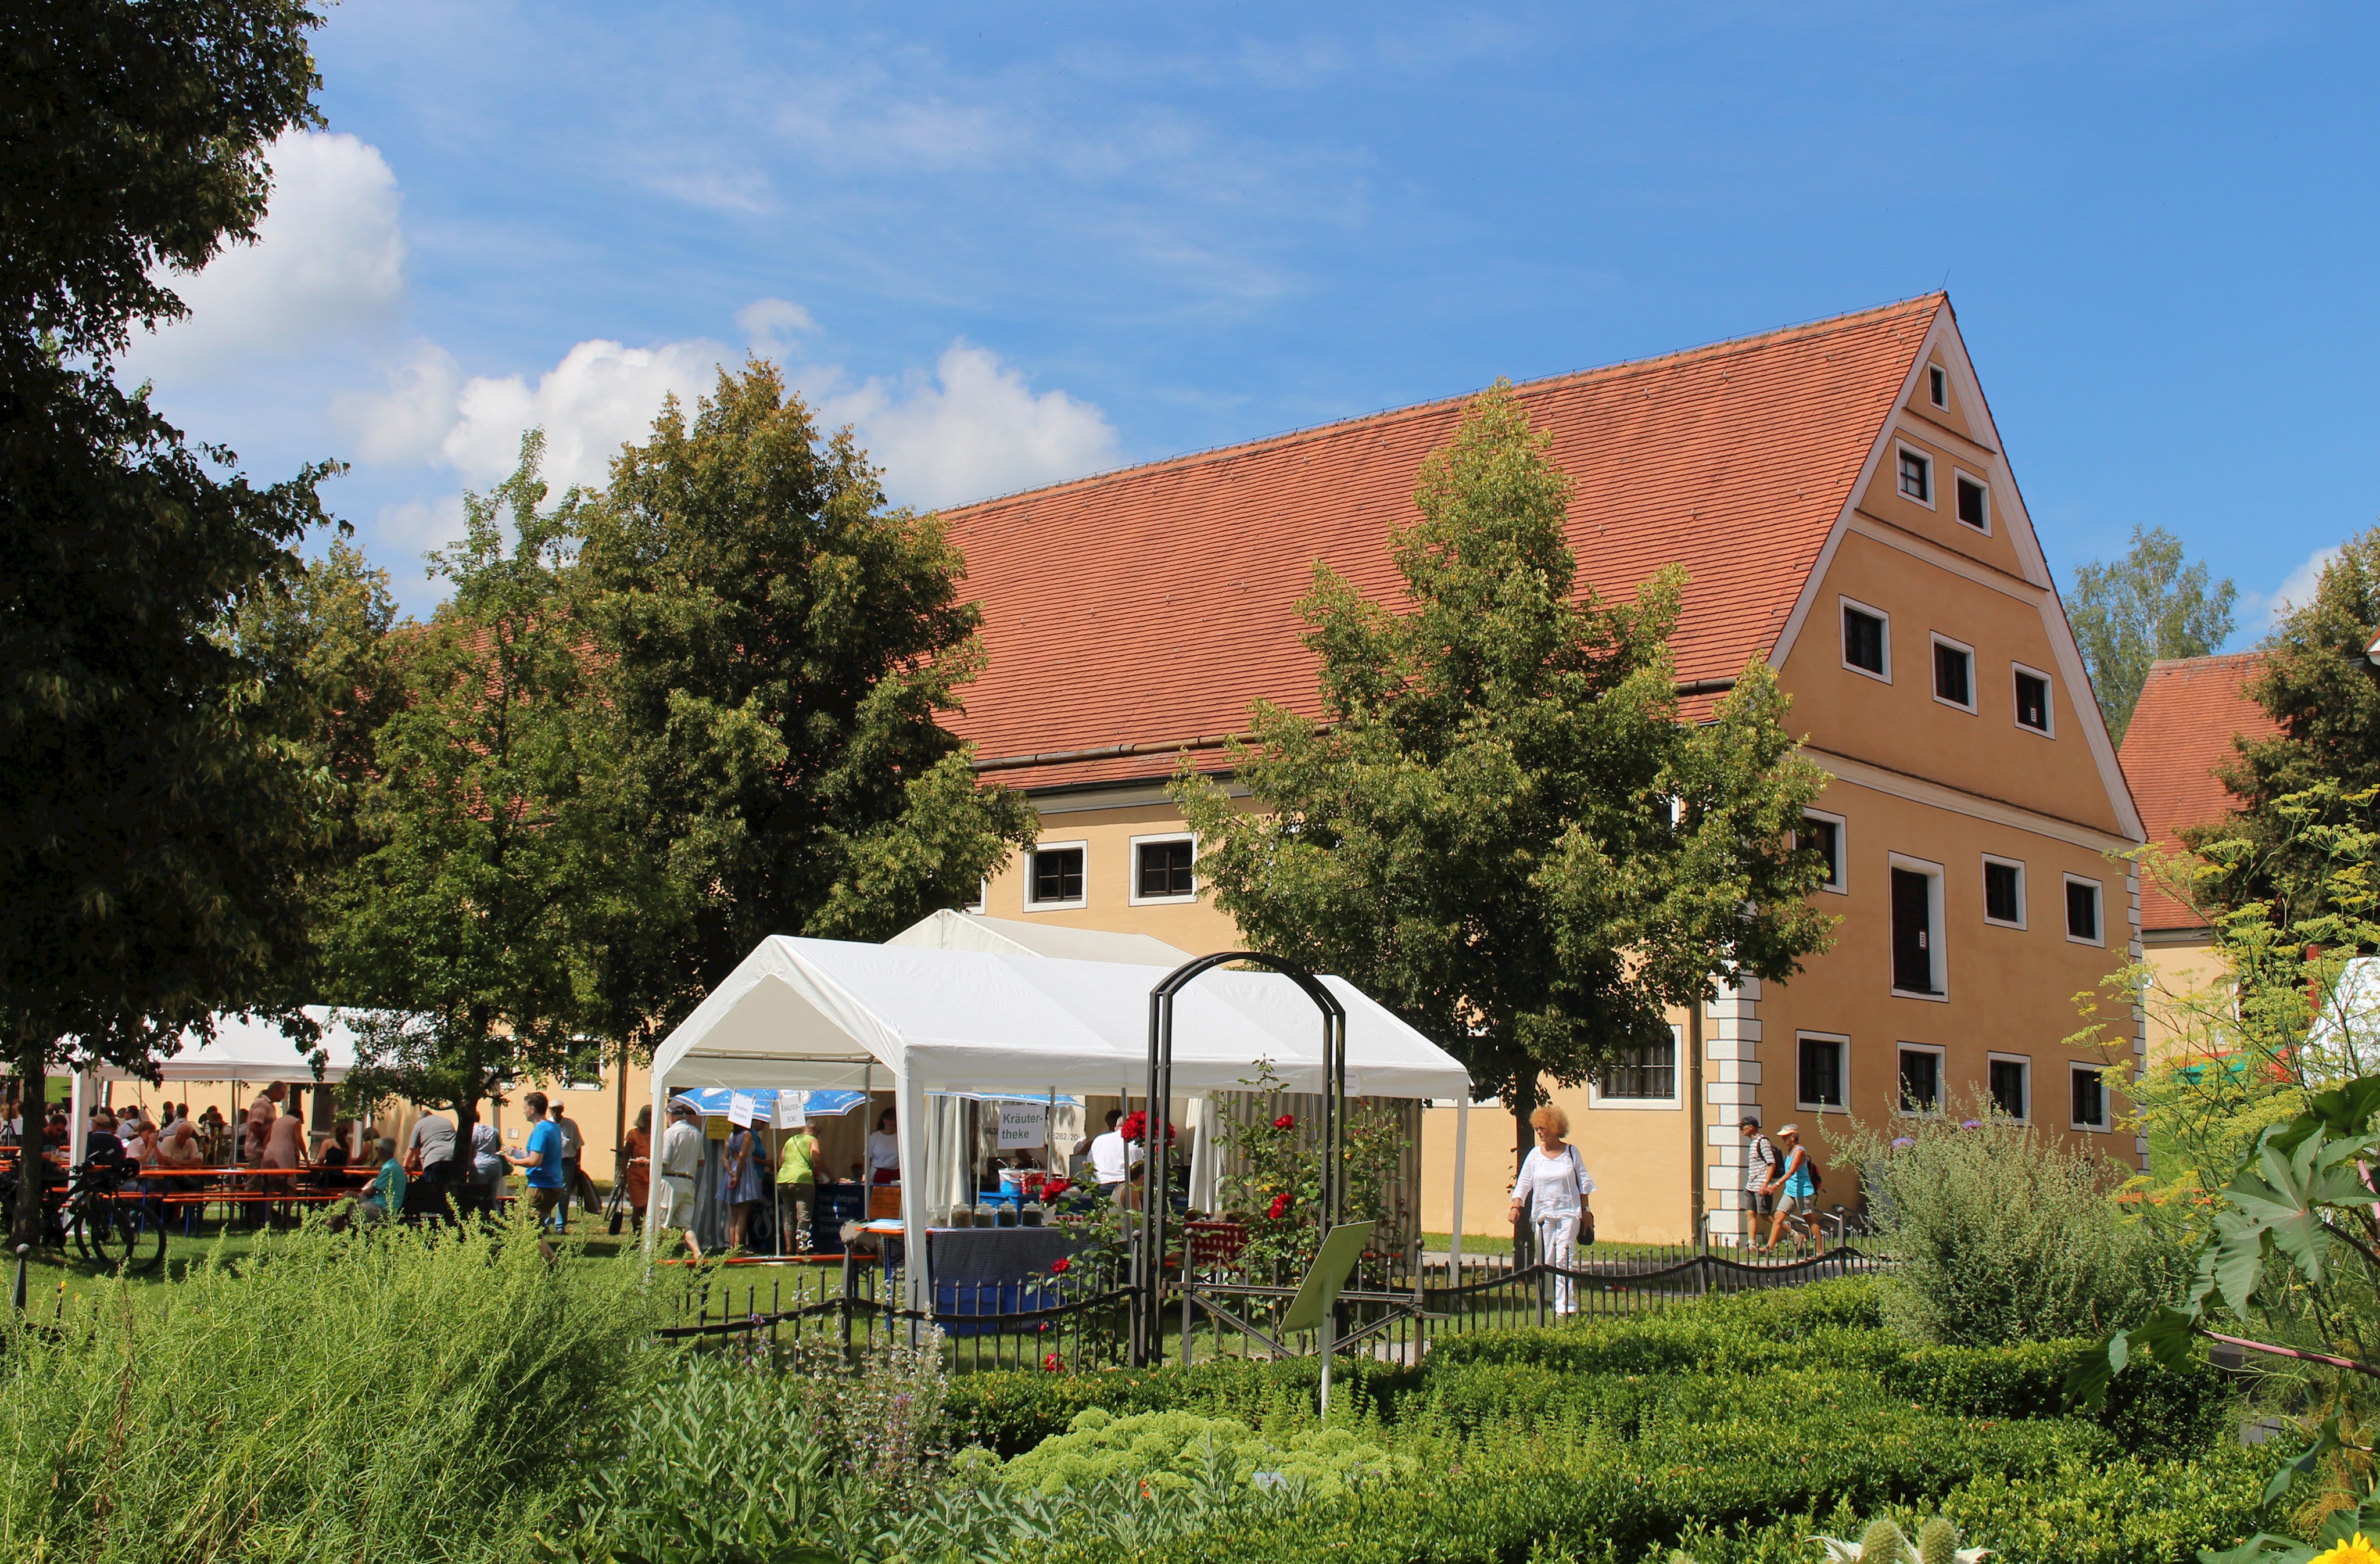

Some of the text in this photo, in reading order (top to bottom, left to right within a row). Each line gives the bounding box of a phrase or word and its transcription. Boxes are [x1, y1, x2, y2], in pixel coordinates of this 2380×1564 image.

[781, 1103, 801, 1111] KRÄUTER-
[1003, 1113, 1043, 1124] Kräuter-
[1002, 1129, 1029, 1139] theke
